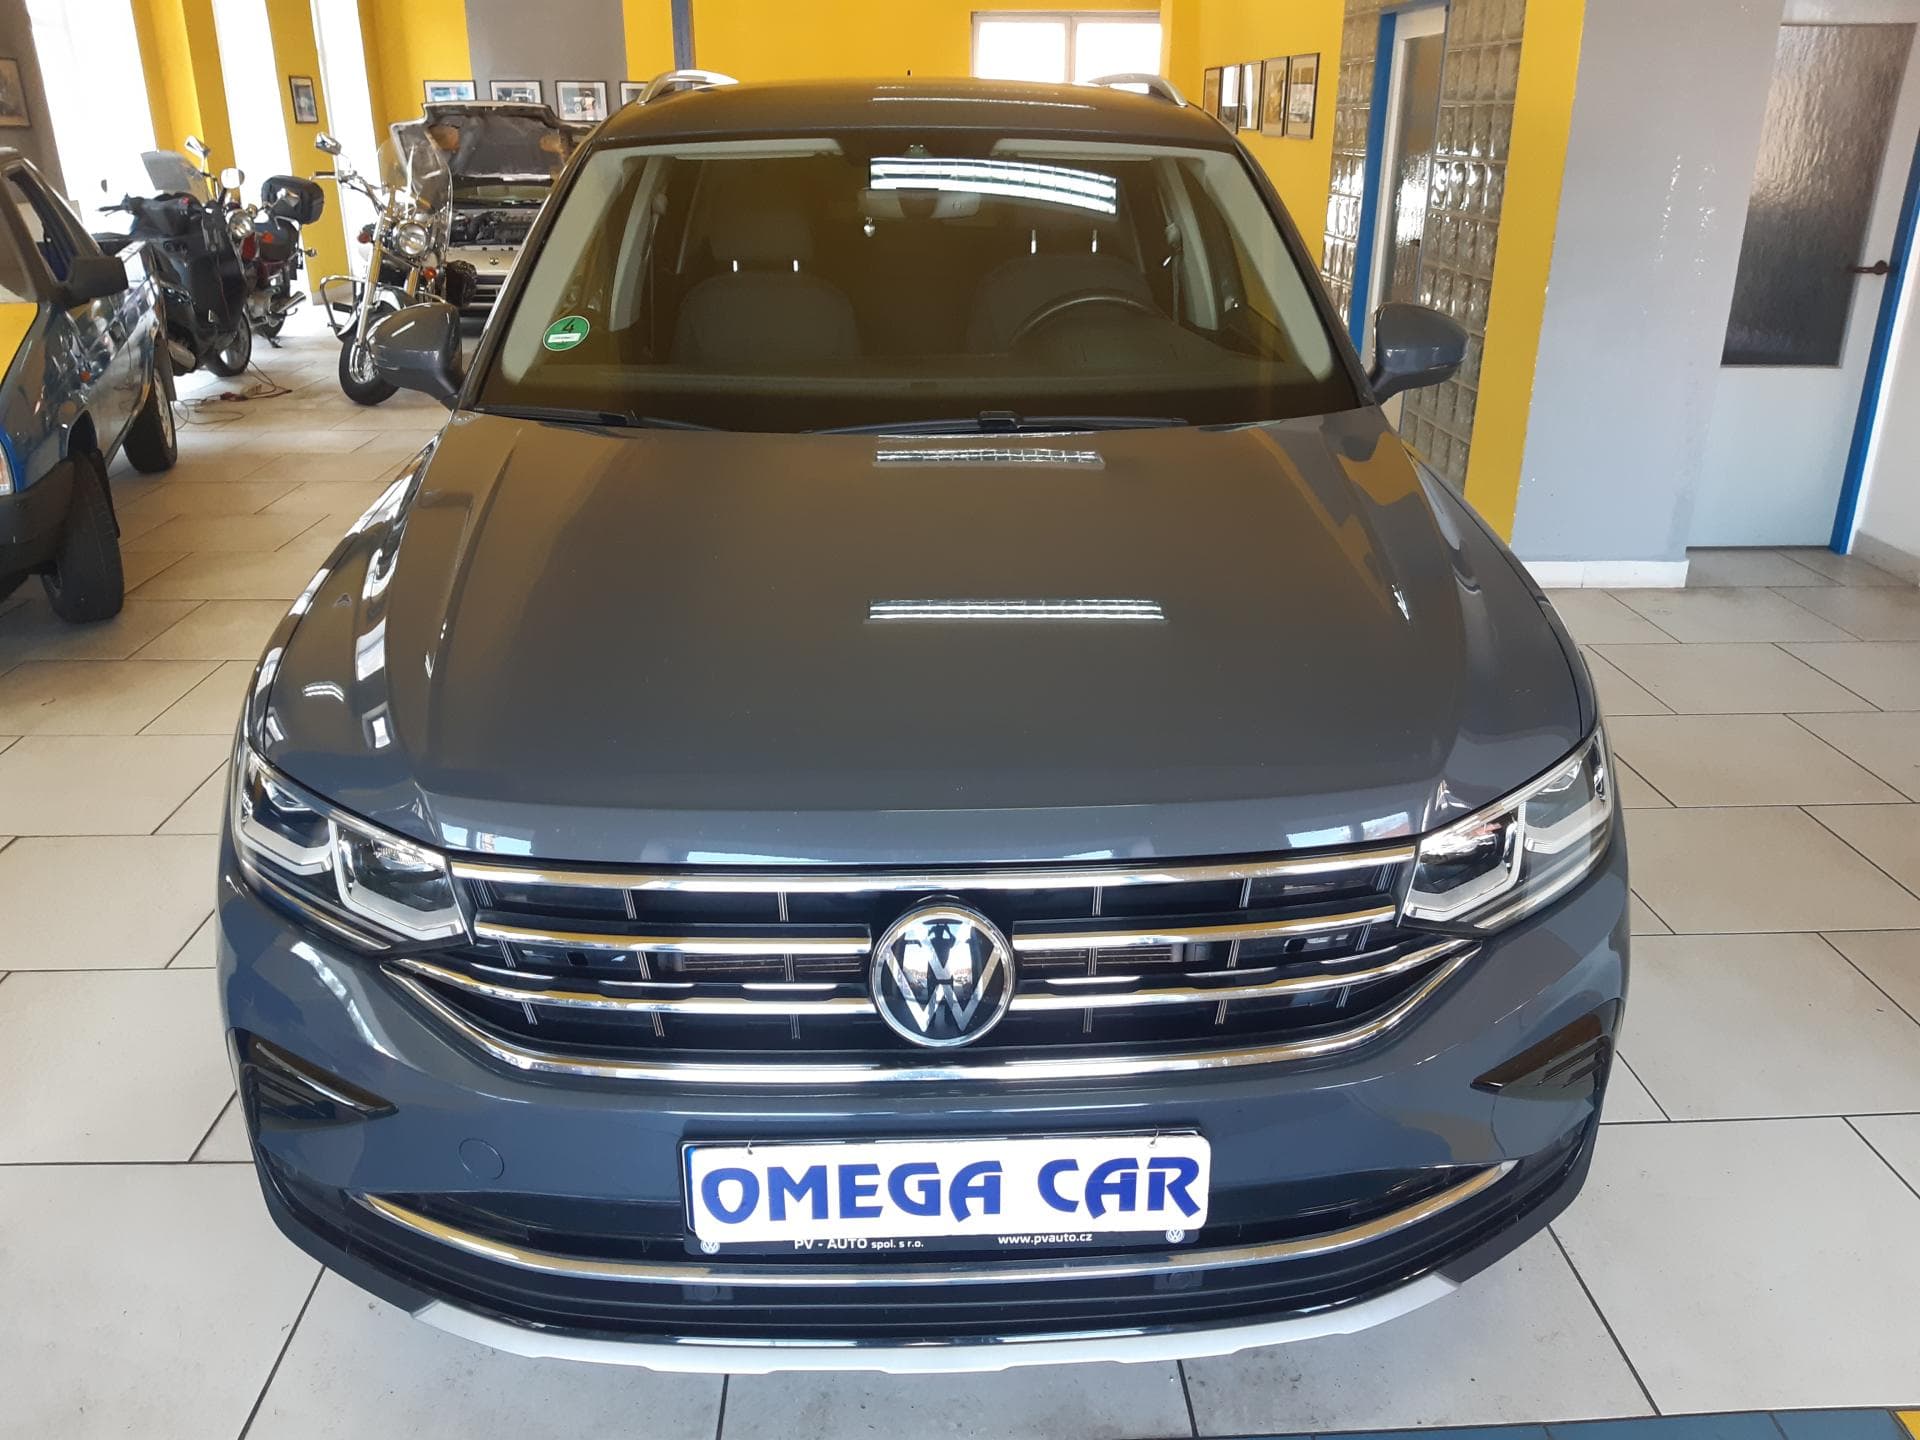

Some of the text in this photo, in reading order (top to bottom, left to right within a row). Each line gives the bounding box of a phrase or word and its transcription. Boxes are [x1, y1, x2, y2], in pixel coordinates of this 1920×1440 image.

[562, 318, 575, 333] 4
[701, 1156, 1201, 1224] OMEGA CAR
[794, 1239, 815, 1250] PV
[827, 1238, 868, 1249] AUTO
[871, 1240, 896, 1251] spol.
[898, 1240, 905, 1249] s
[907, 1239, 924, 1249] r.o.
[998, 1232, 1093, 1246] www.pvauto.cz
